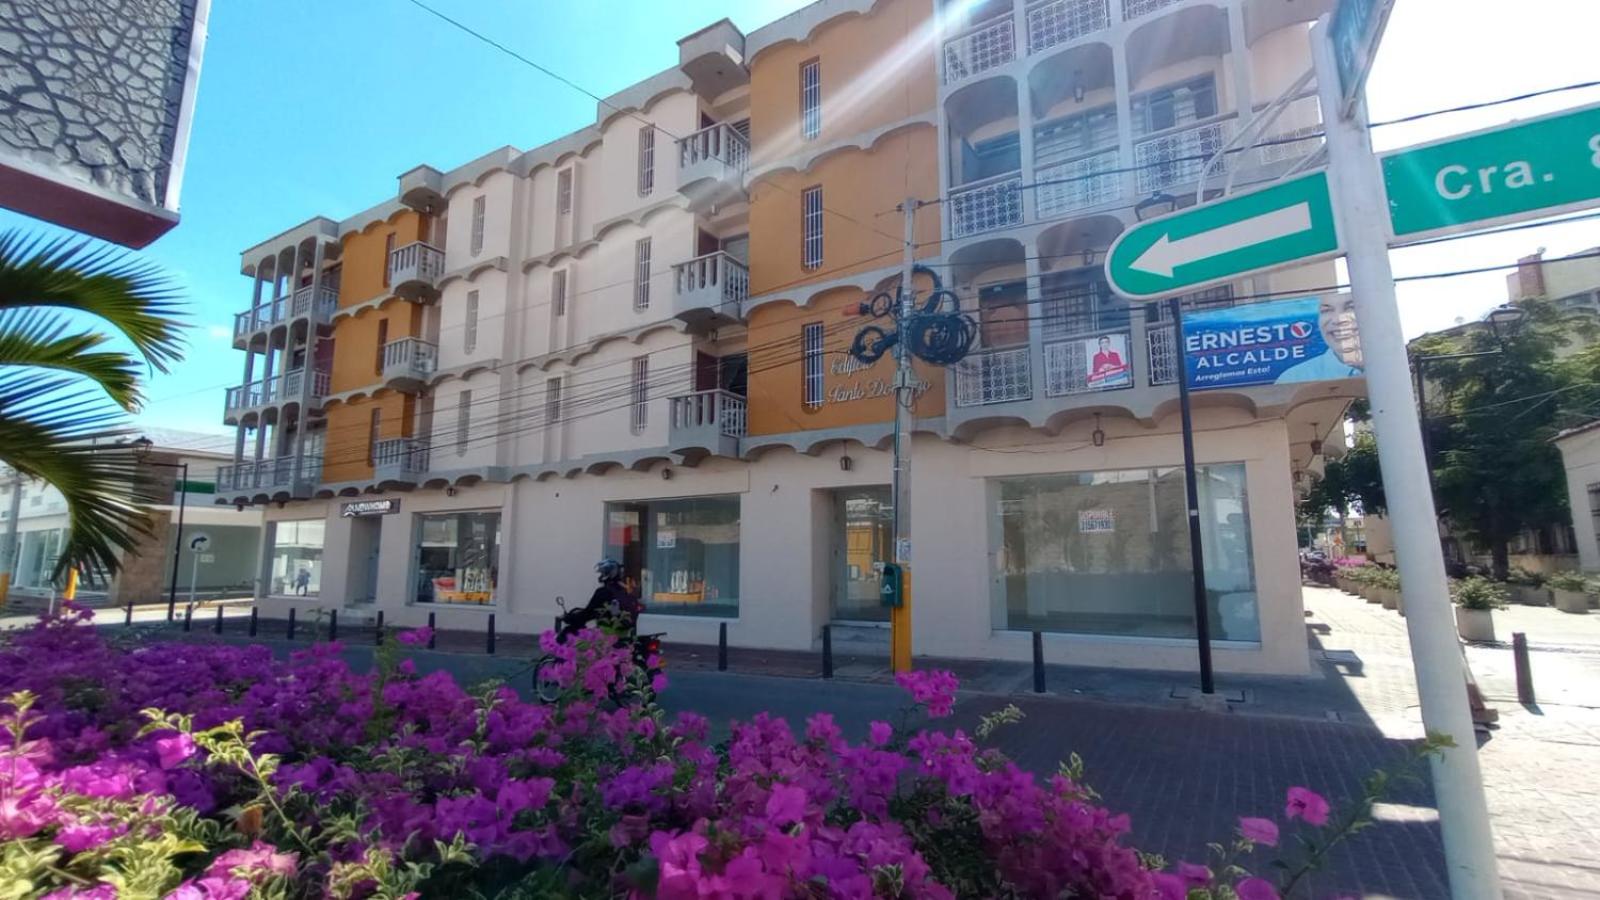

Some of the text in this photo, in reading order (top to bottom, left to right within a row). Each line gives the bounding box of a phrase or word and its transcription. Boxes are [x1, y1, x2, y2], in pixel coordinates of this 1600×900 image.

[1435, 159, 1555, 200] Cra.
[1186, 321, 1312, 352] ERNESTO
[1196, 344, 1306, 369] ALCALDE
